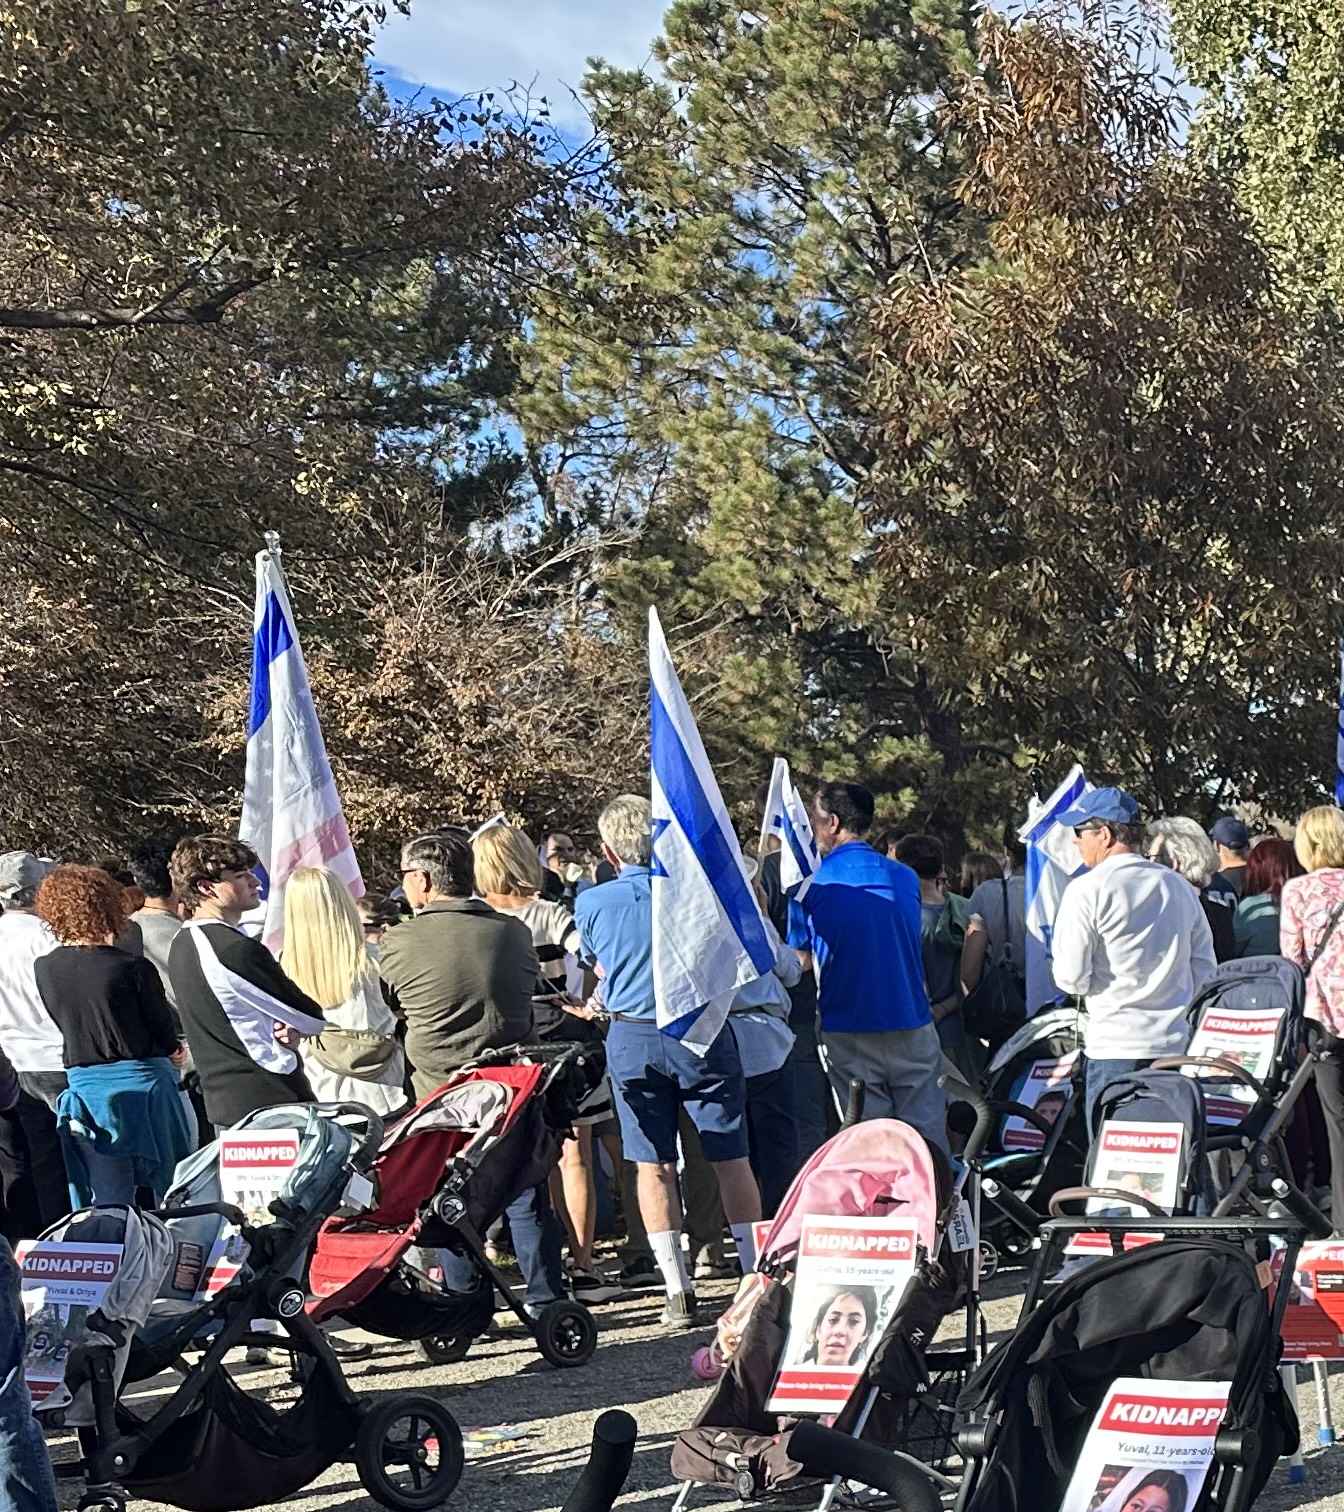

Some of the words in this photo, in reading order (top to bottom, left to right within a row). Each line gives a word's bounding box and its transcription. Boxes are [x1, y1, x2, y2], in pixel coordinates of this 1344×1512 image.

[1204, 1017, 1278, 1034] KIDNAPPED
[1106, 1133, 1178, 1149] KIDNAPPED
[223, 1145, 296, 1162] KIDNAPPED
[806, 1232, 911, 1253] KIDNAPPED
[21, 1256, 115, 1275] KIDNAPPED
